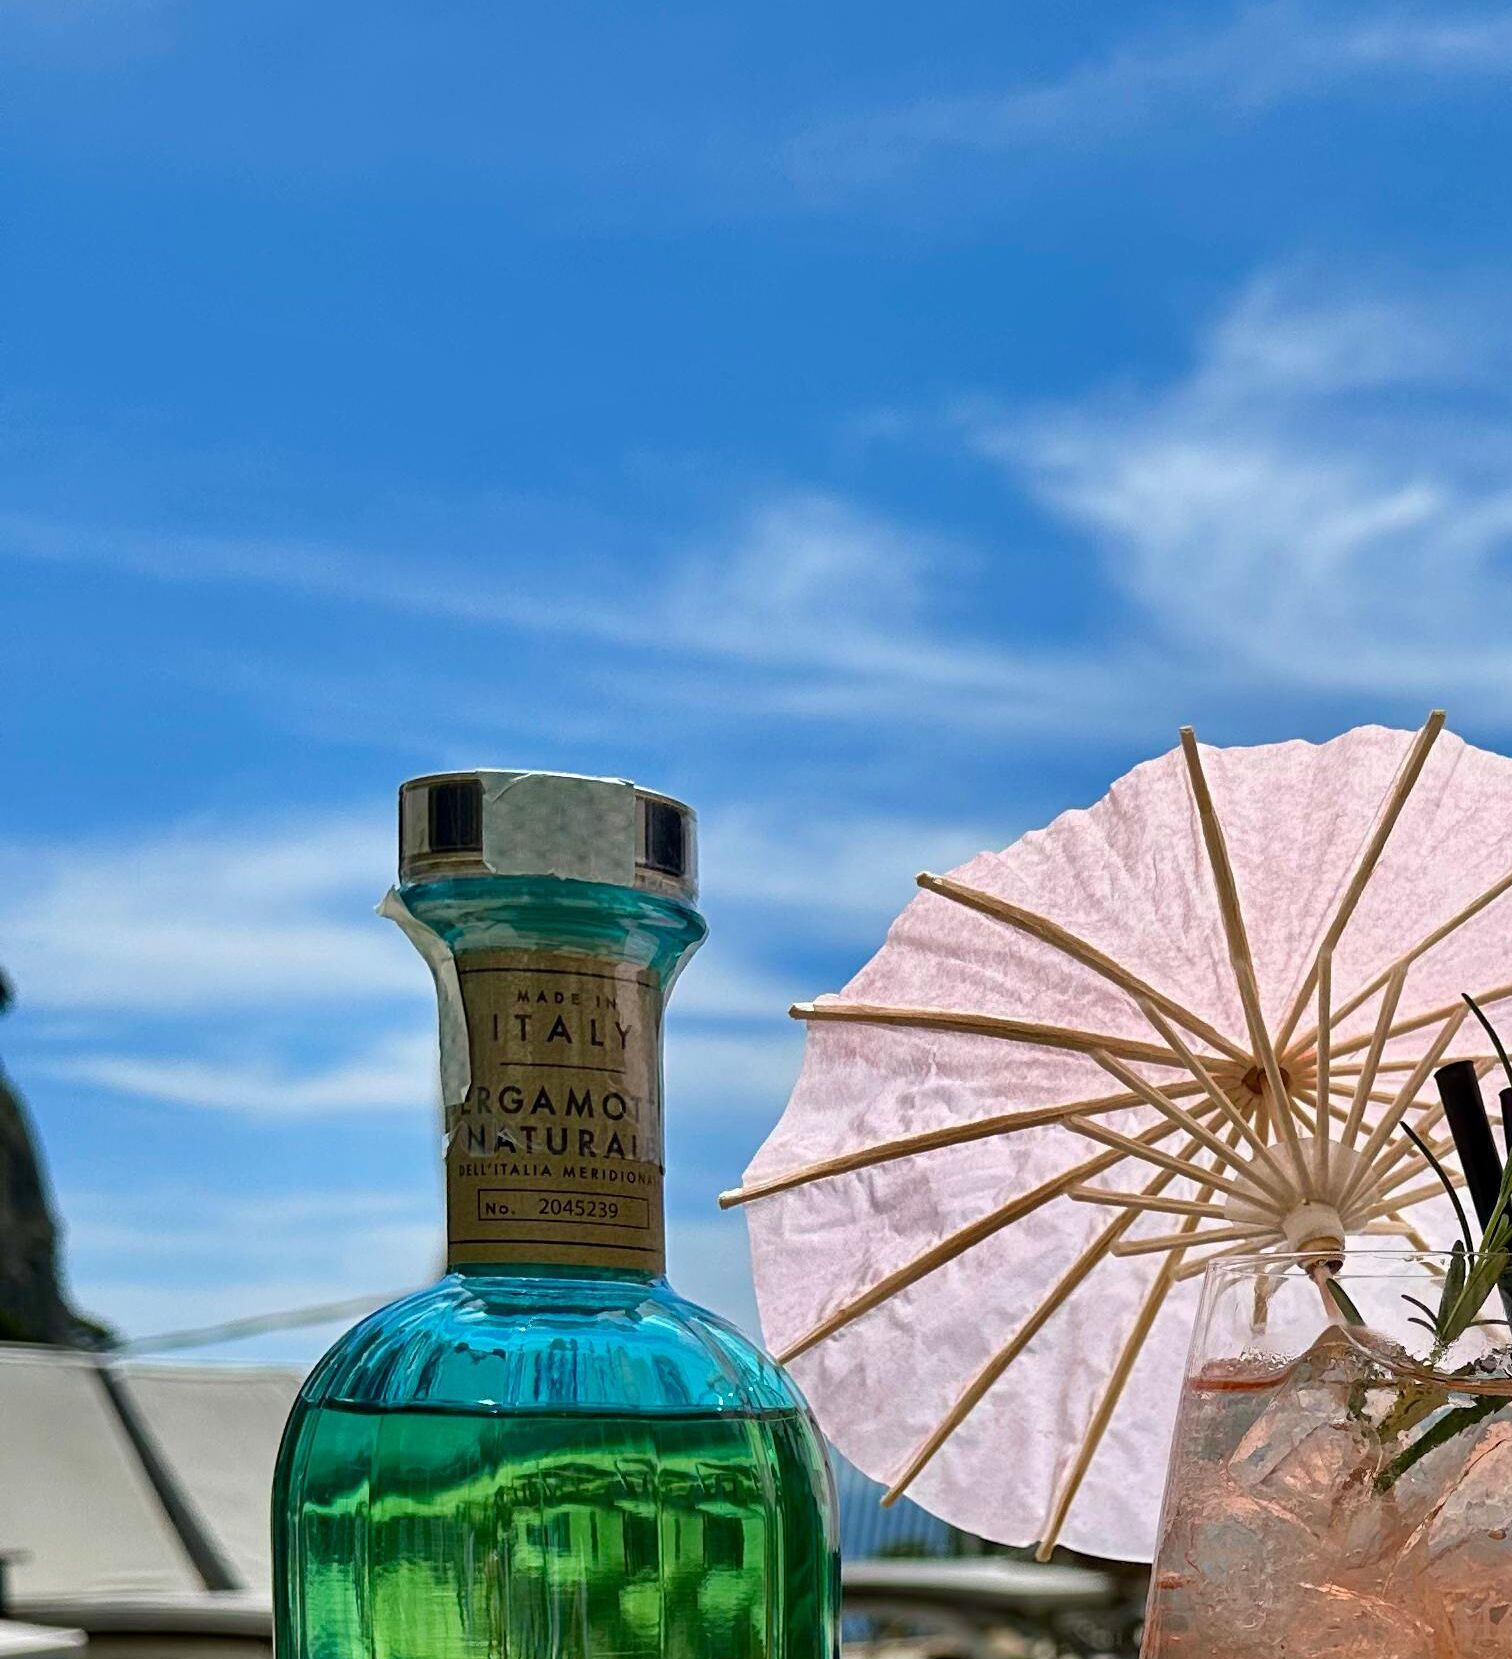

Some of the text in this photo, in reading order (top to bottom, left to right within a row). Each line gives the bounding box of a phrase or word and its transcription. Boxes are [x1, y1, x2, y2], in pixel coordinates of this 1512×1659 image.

[517, 989, 617, 1010] MADE IN
[492, 1013, 632, 1050] ITALY
[458, 1162, 552, 1178] DELL'ITALIA
[485, 1198, 619, 1219] No. 2045239
